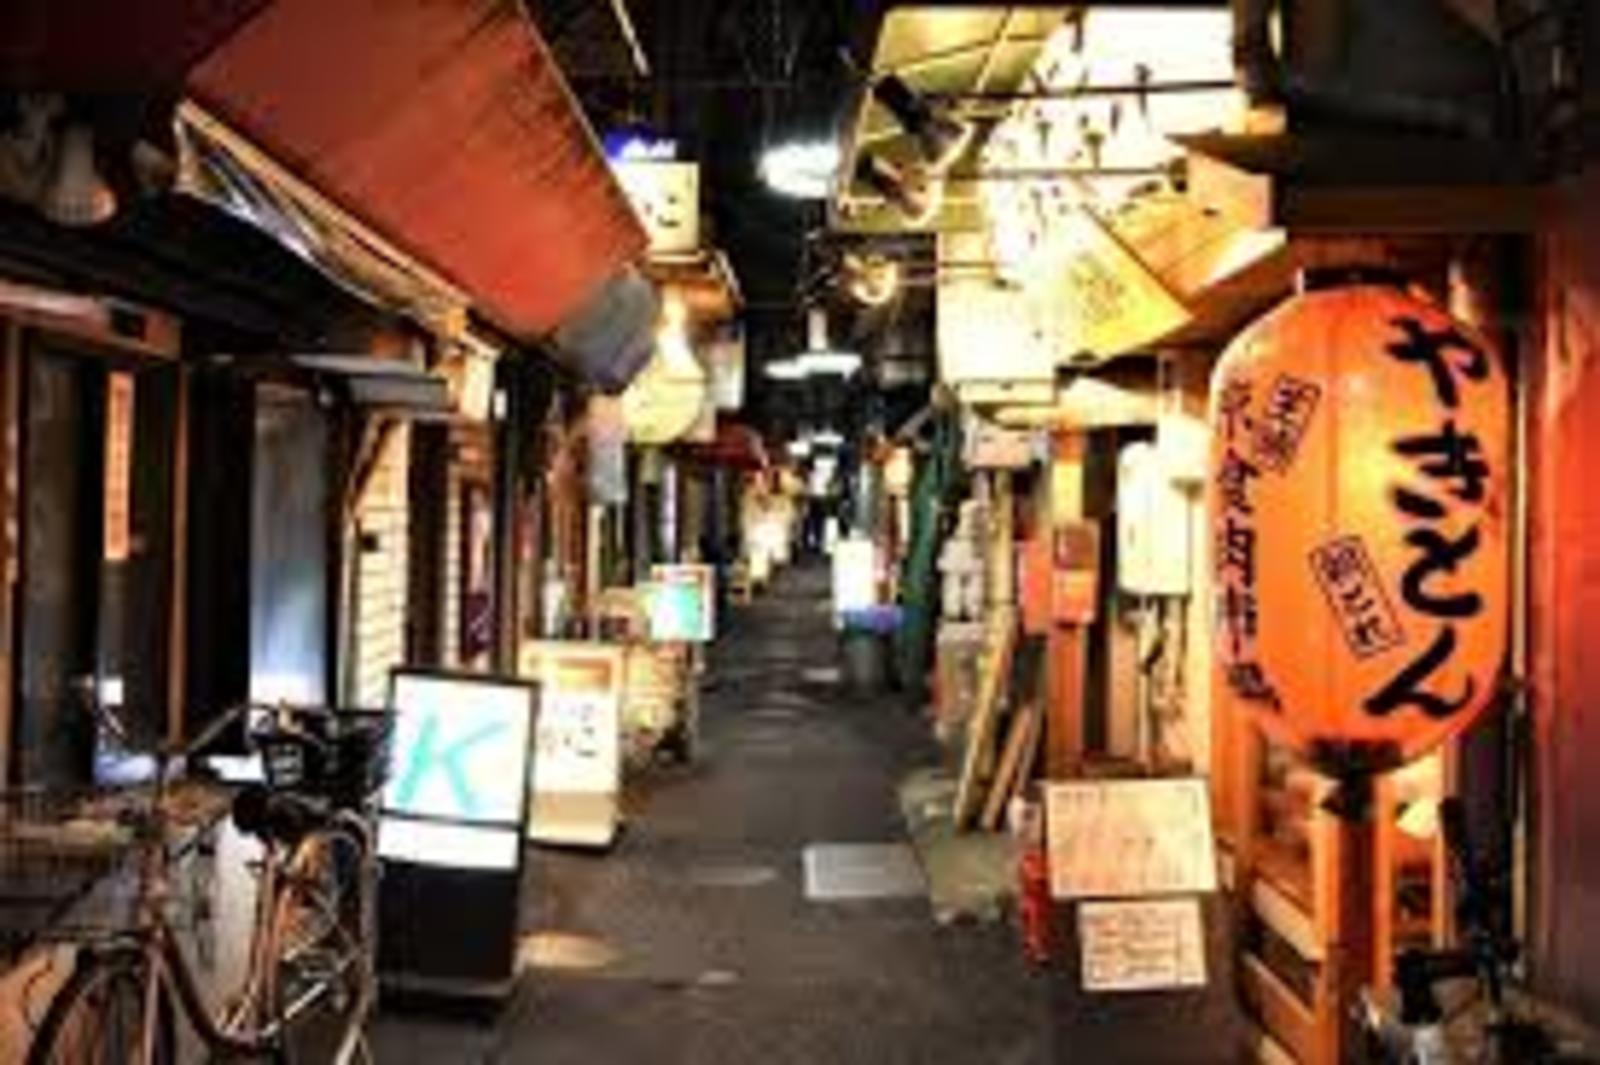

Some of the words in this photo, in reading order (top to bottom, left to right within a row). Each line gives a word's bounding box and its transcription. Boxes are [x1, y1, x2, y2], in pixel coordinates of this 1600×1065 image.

[1363, 316, 1489, 718] やきとん
[394, 708, 507, 815] K
